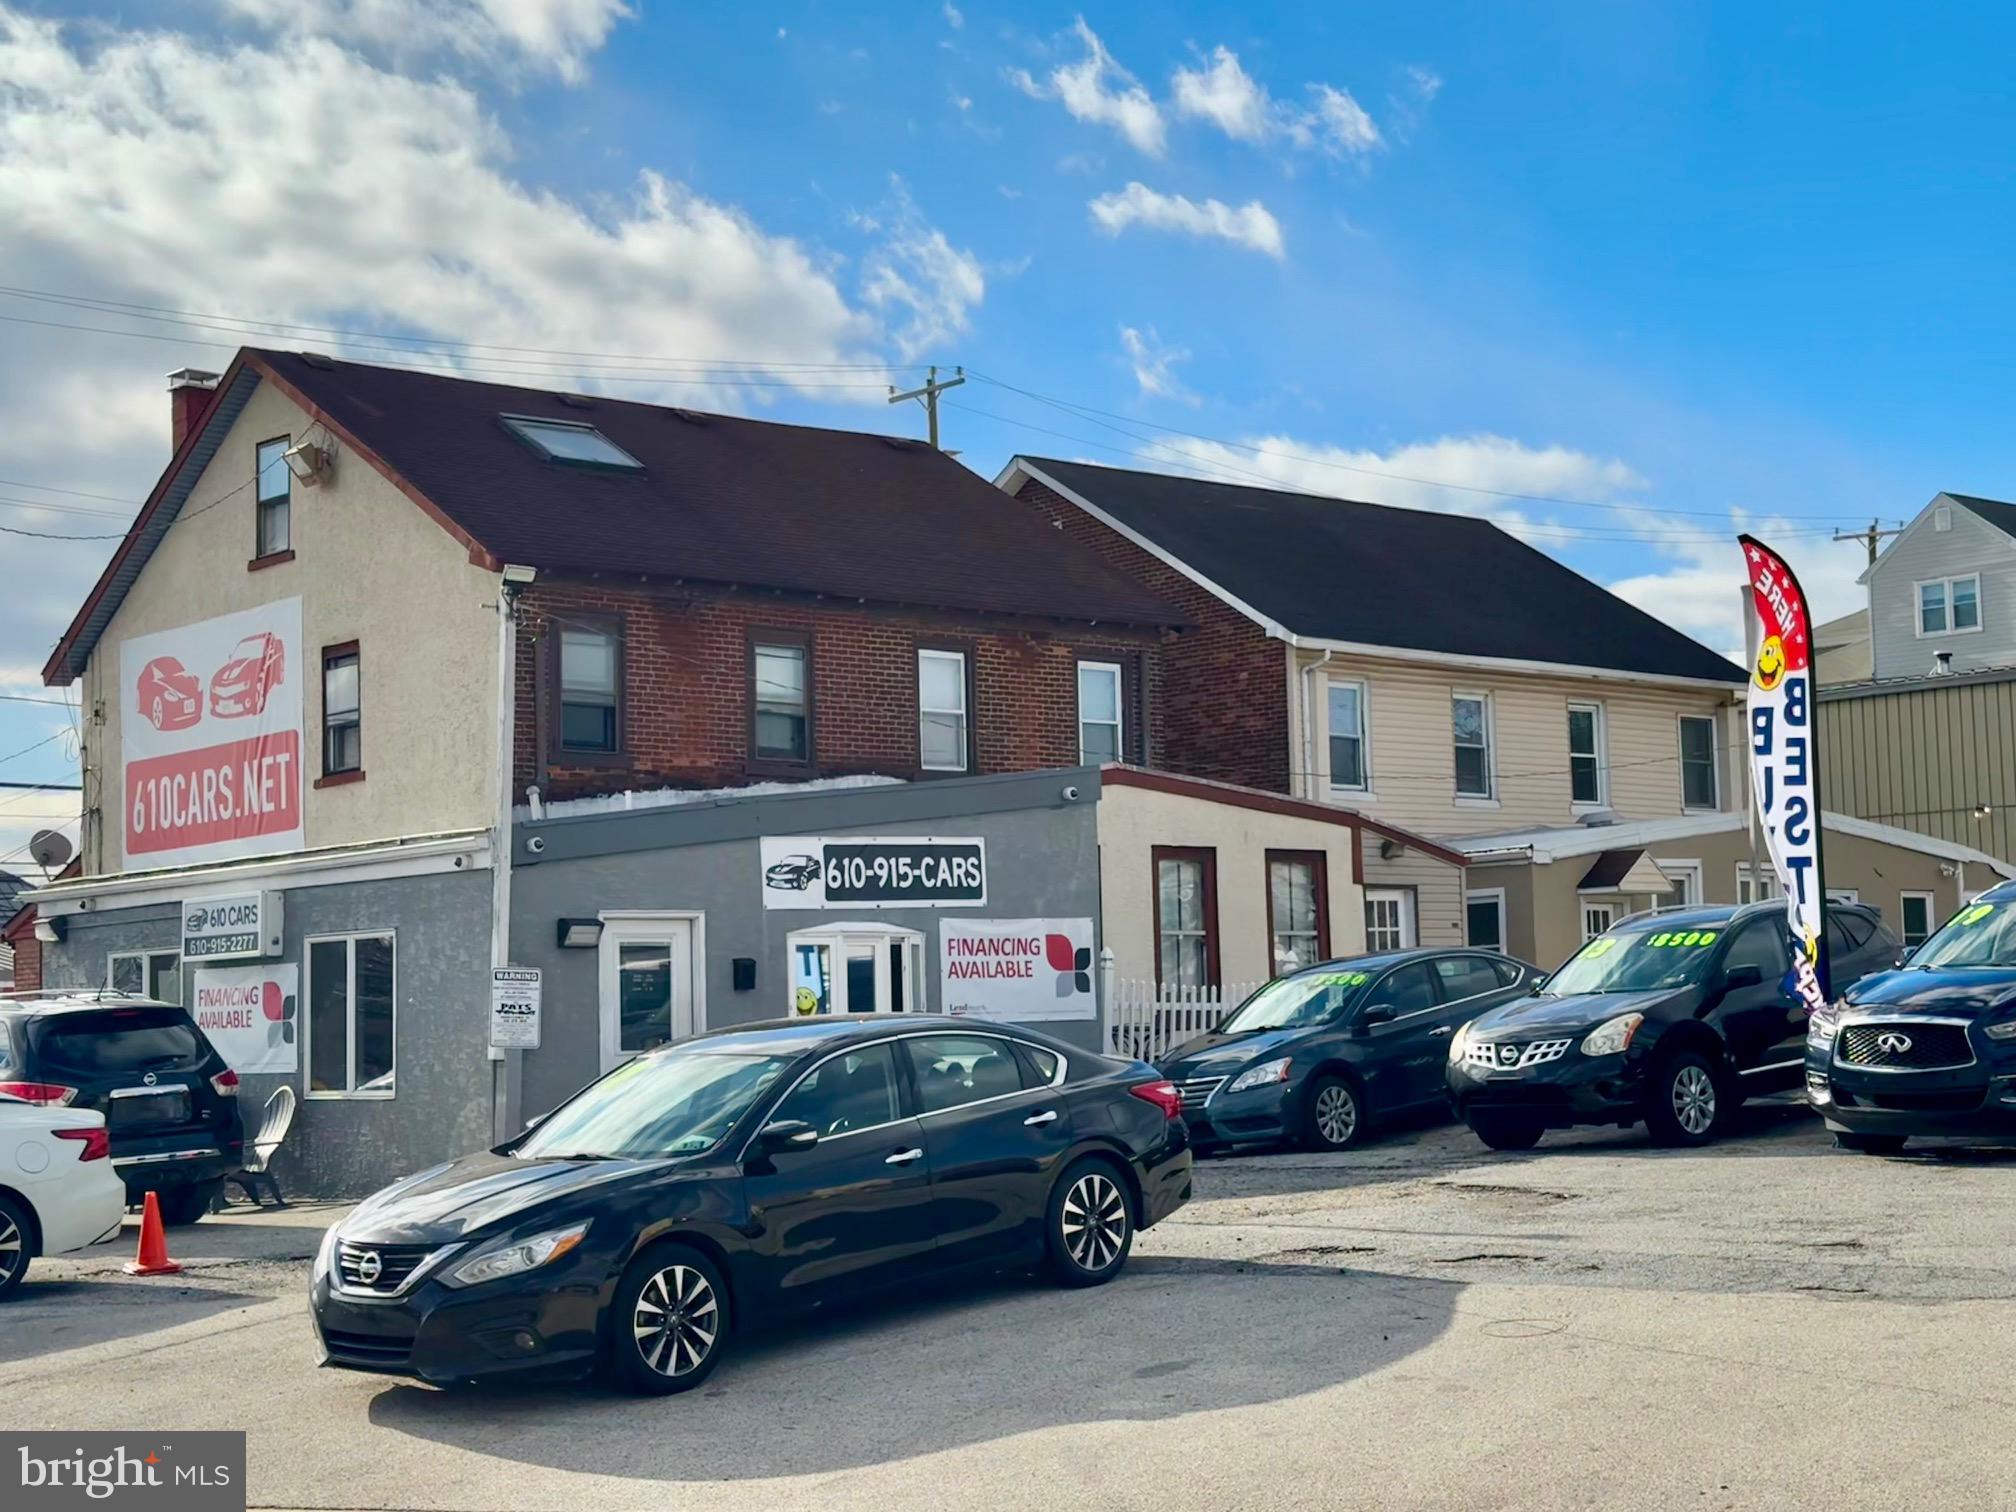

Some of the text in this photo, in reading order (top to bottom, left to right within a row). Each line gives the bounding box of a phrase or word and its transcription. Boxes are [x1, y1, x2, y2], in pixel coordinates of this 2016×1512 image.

[133, 752, 291, 834] 610CARS.NET
[826, 856, 982, 889] 610-915-CARS
[209, 904, 258, 929] 610 CARS
[189, 935, 256, 955] 610-915-2277
[948, 937, 1041, 957] FINANCING
[495, 971, 538, 981] WARNING
[948, 960, 1034, 979] AVAILABLE
[198, 986, 260, 1007] FINANCING
[198, 1010, 253, 1030] AVAILABLE
